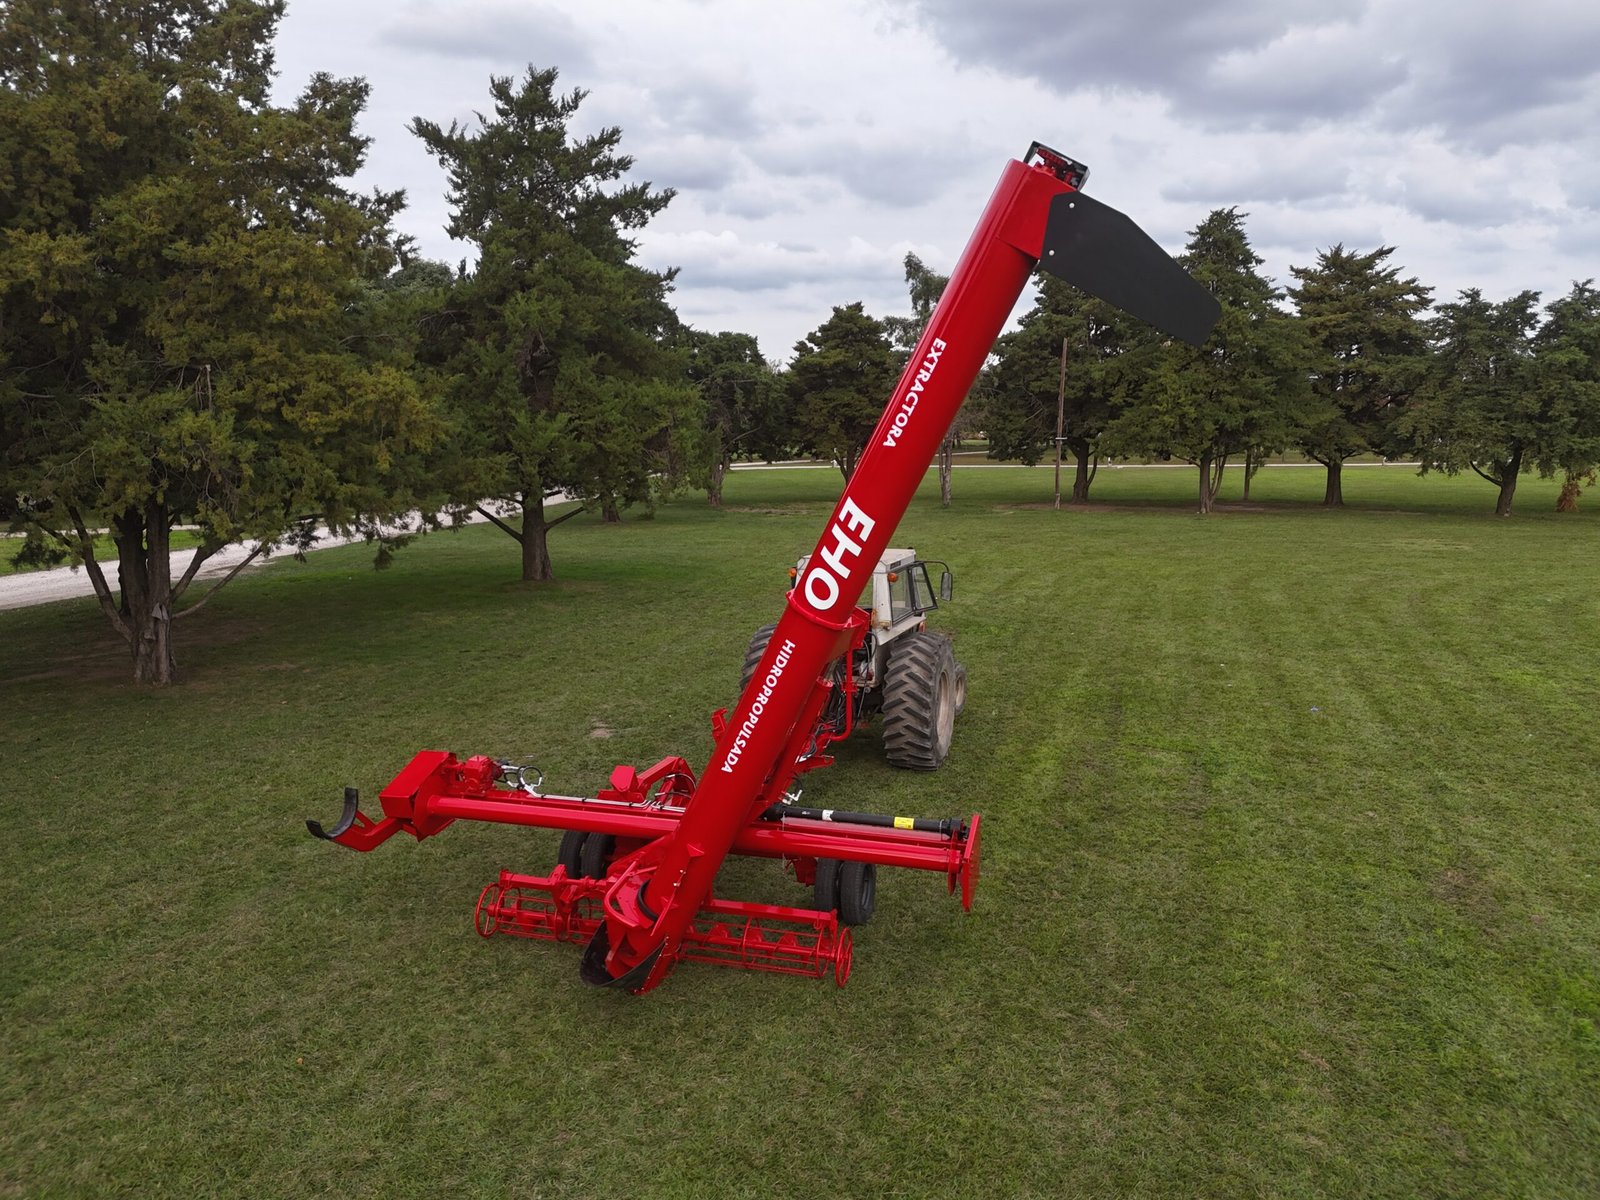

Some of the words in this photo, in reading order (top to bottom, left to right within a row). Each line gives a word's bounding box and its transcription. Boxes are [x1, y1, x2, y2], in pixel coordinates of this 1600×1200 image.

[883, 338, 947, 447] EXTRACTORA
[805, 496, 876, 611] EHO
[721, 639, 796, 774] HIDROPROPULSADA
